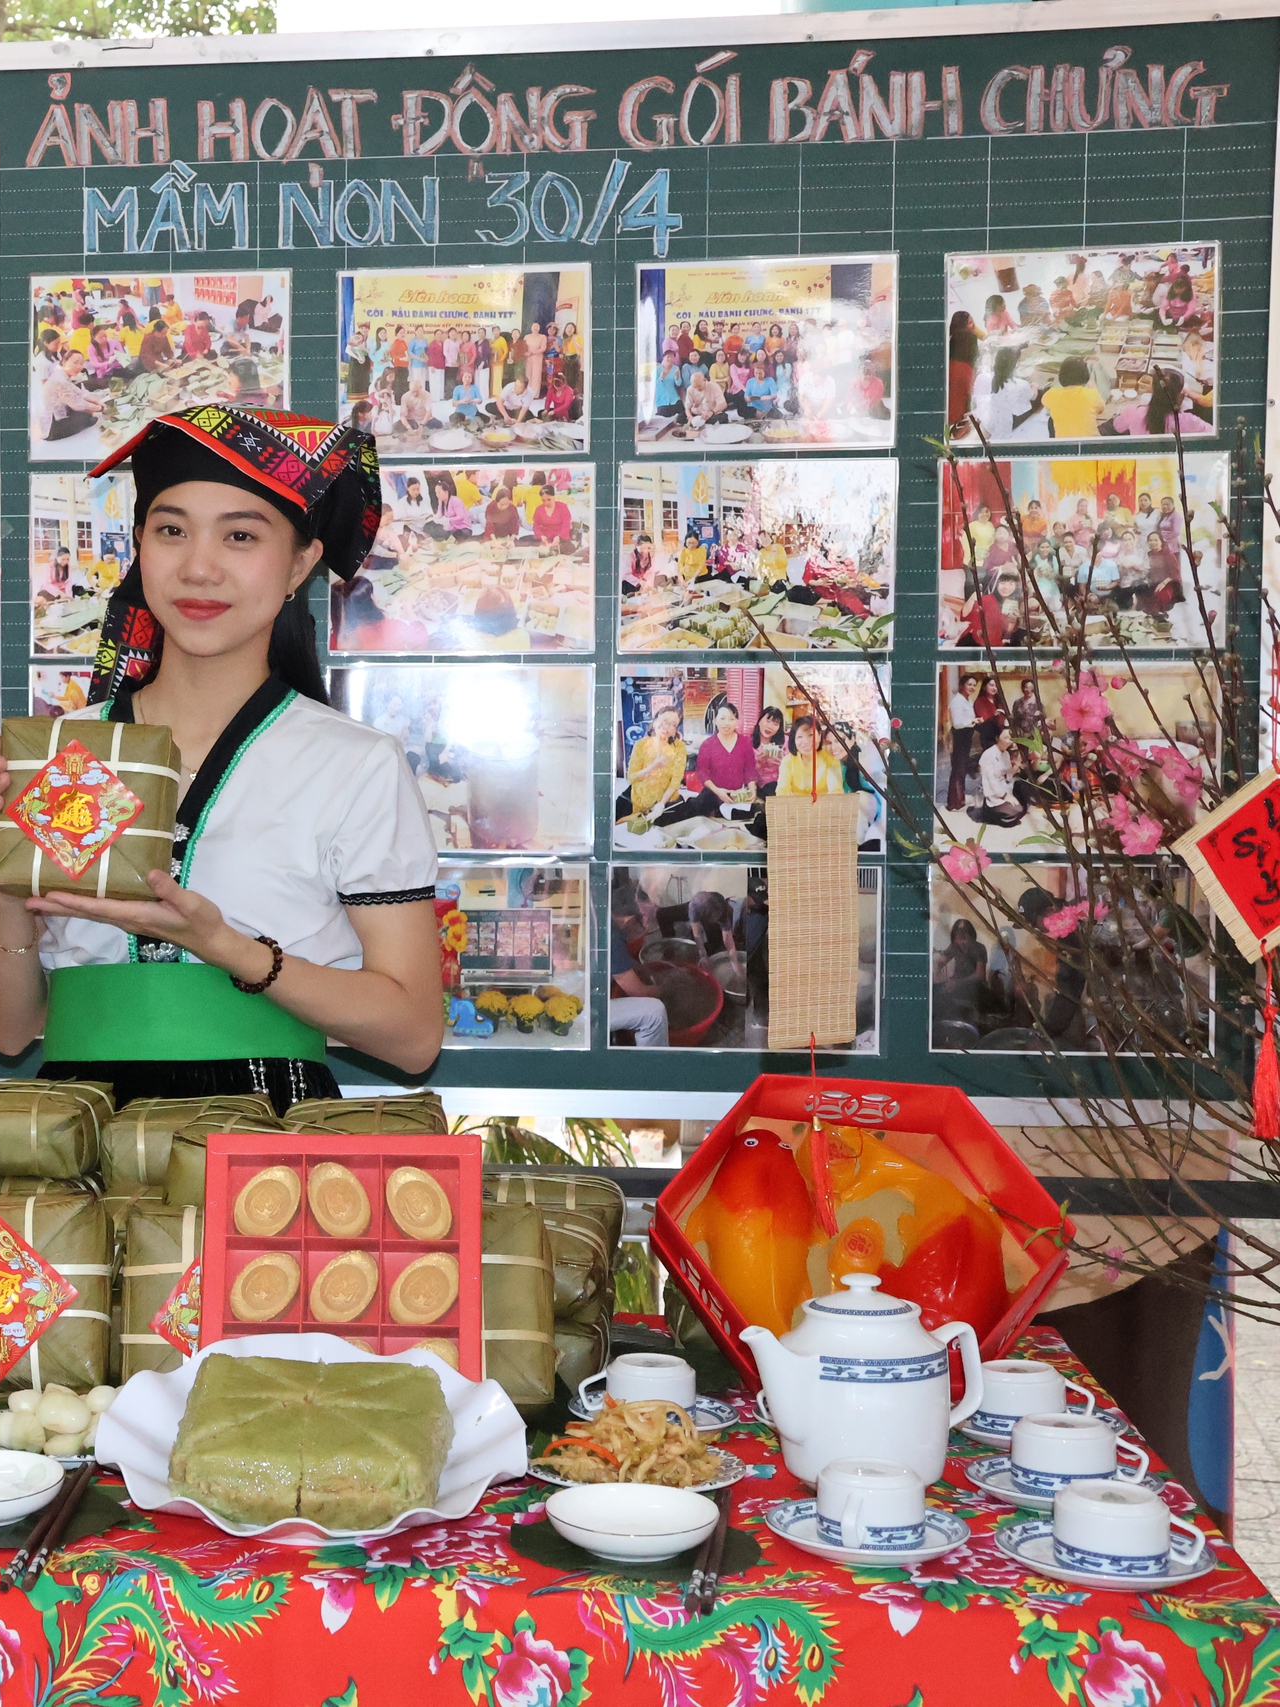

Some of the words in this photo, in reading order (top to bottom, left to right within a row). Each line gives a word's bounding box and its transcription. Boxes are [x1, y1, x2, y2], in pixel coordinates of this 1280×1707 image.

[25, 72, 171, 168] ẢNH
[197, 85, 378, 188] HOẠT
[391, 62, 597, 182] ĐỘNG
[618, 49, 742, 152] GÓI
[767, 49, 963, 144] BÁNH
[83, 159, 250, 255] MẦM
[278, 175, 439, 249] NON
[475, 158, 683, 258] 30/4
